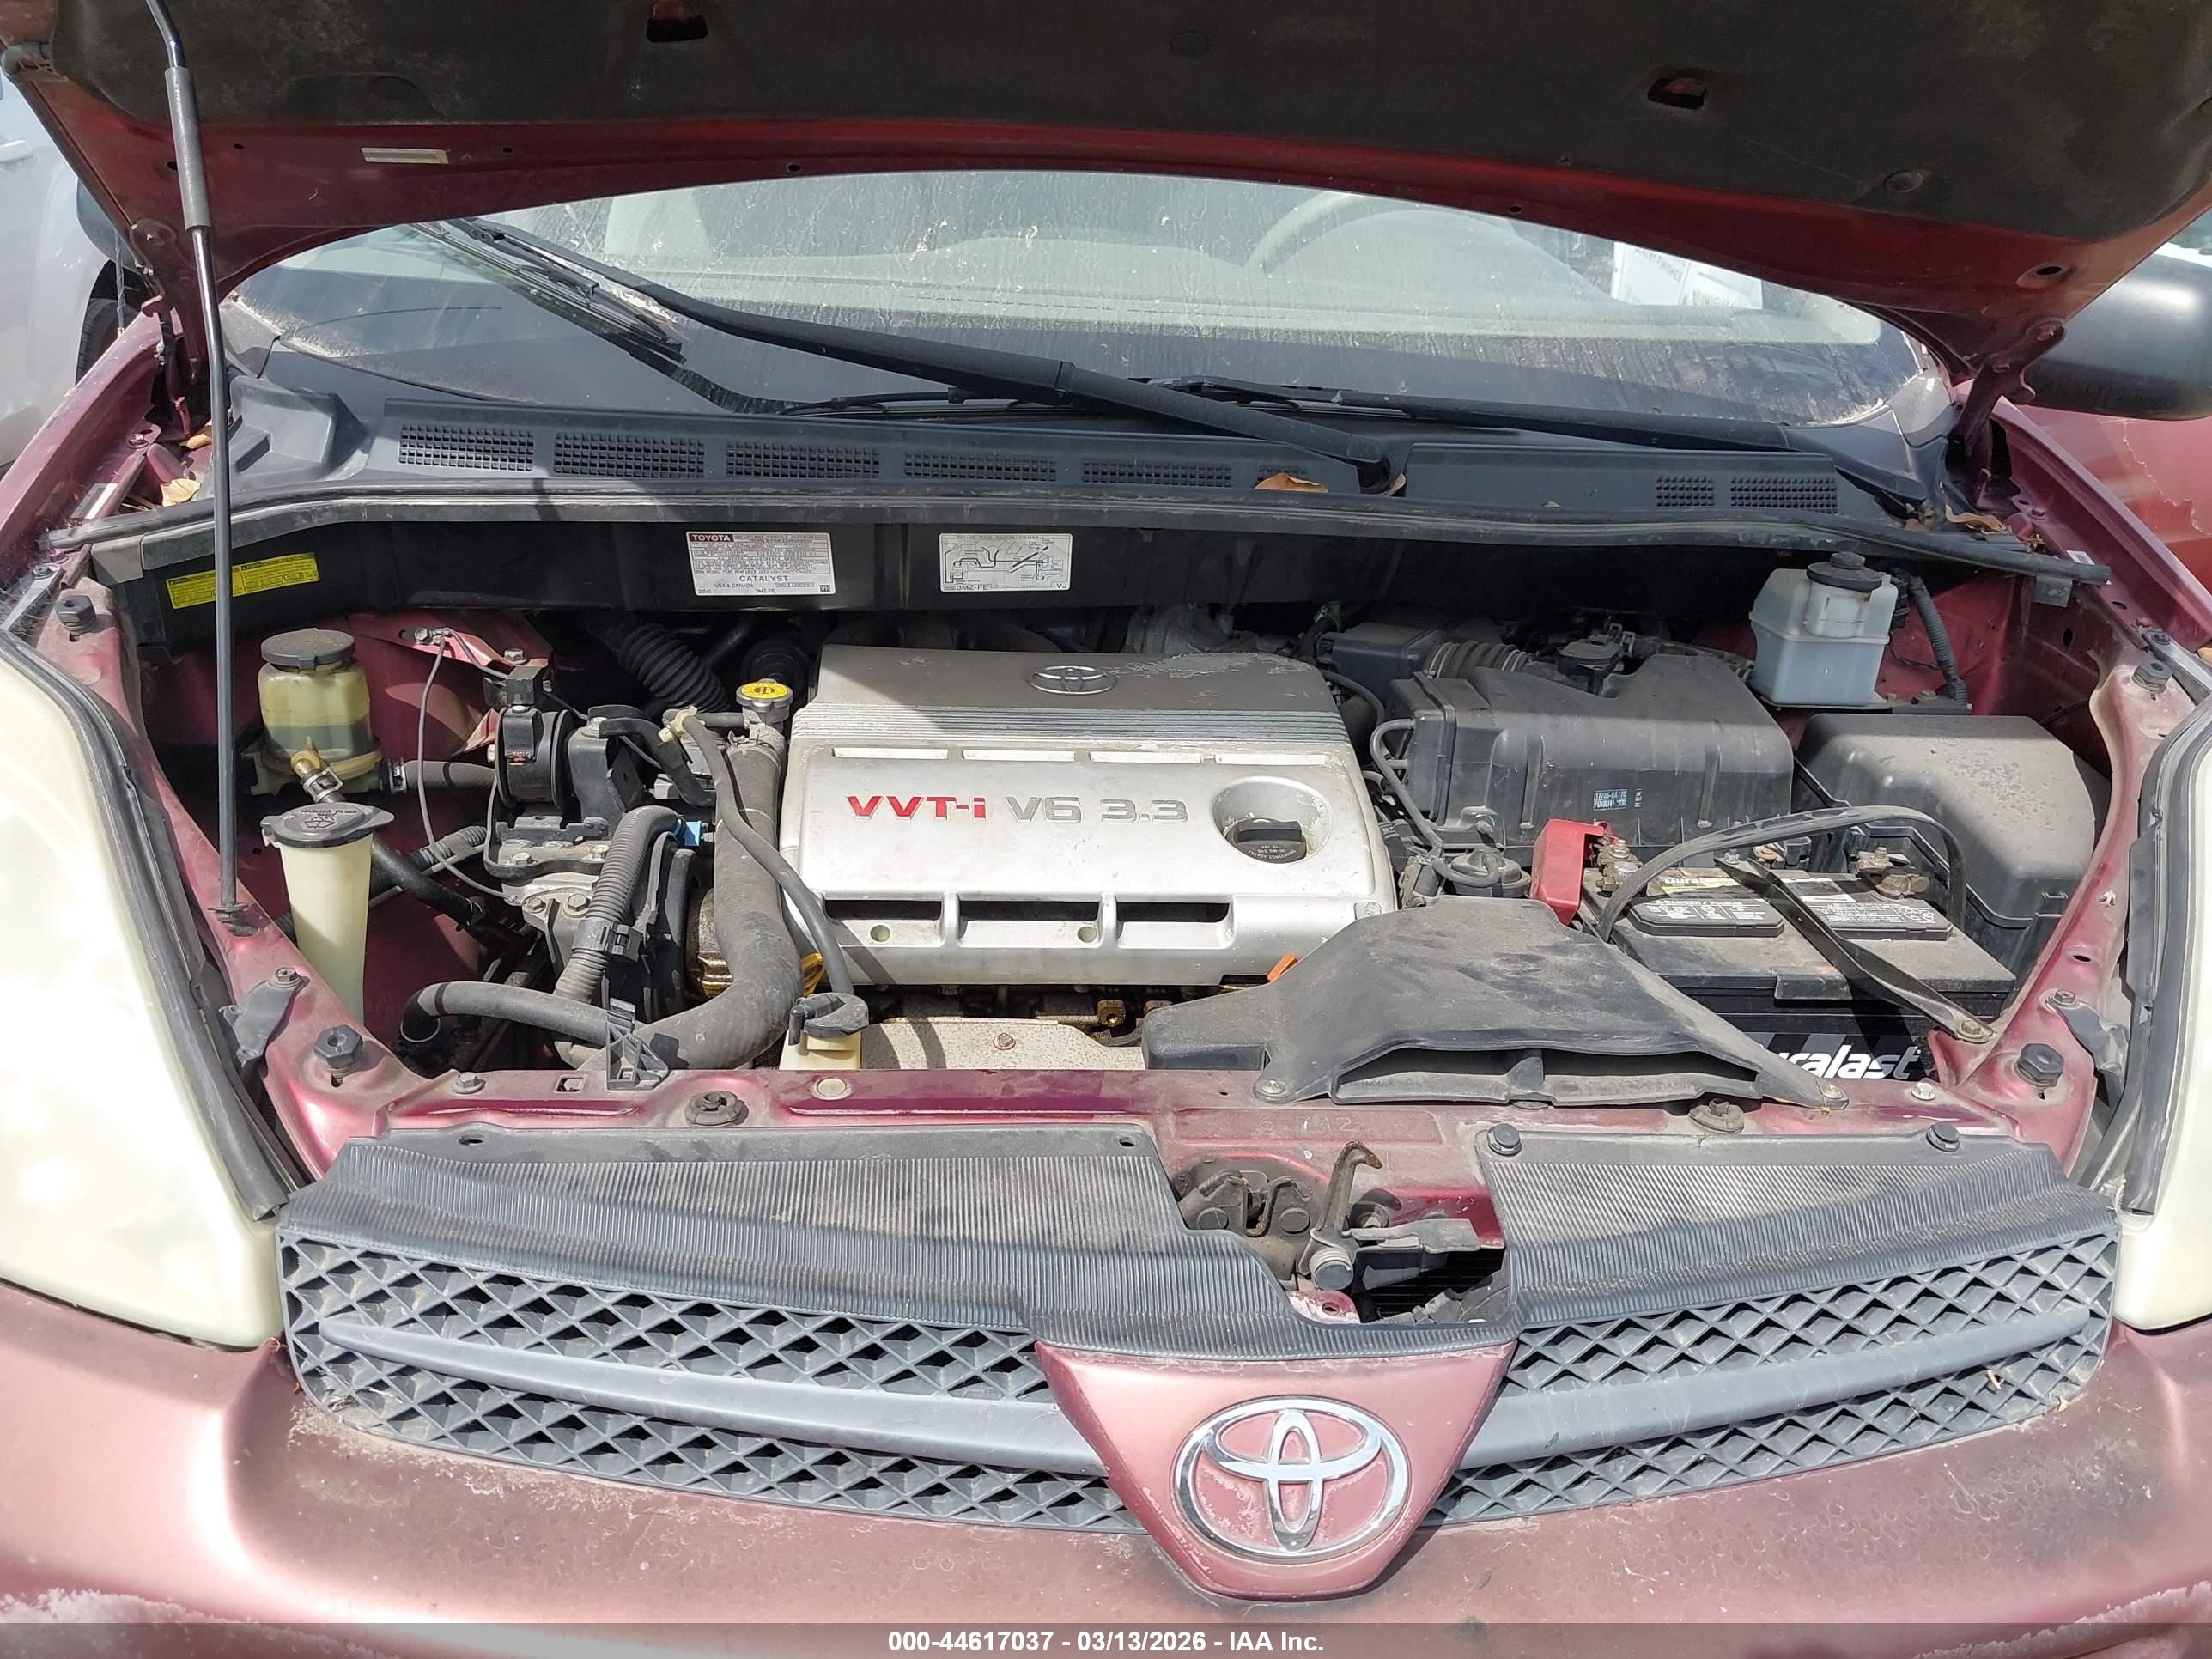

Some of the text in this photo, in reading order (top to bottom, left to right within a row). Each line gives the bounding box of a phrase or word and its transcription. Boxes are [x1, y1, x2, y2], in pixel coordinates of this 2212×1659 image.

[846, 795, 1188, 823] VVT-i V6 3.3
